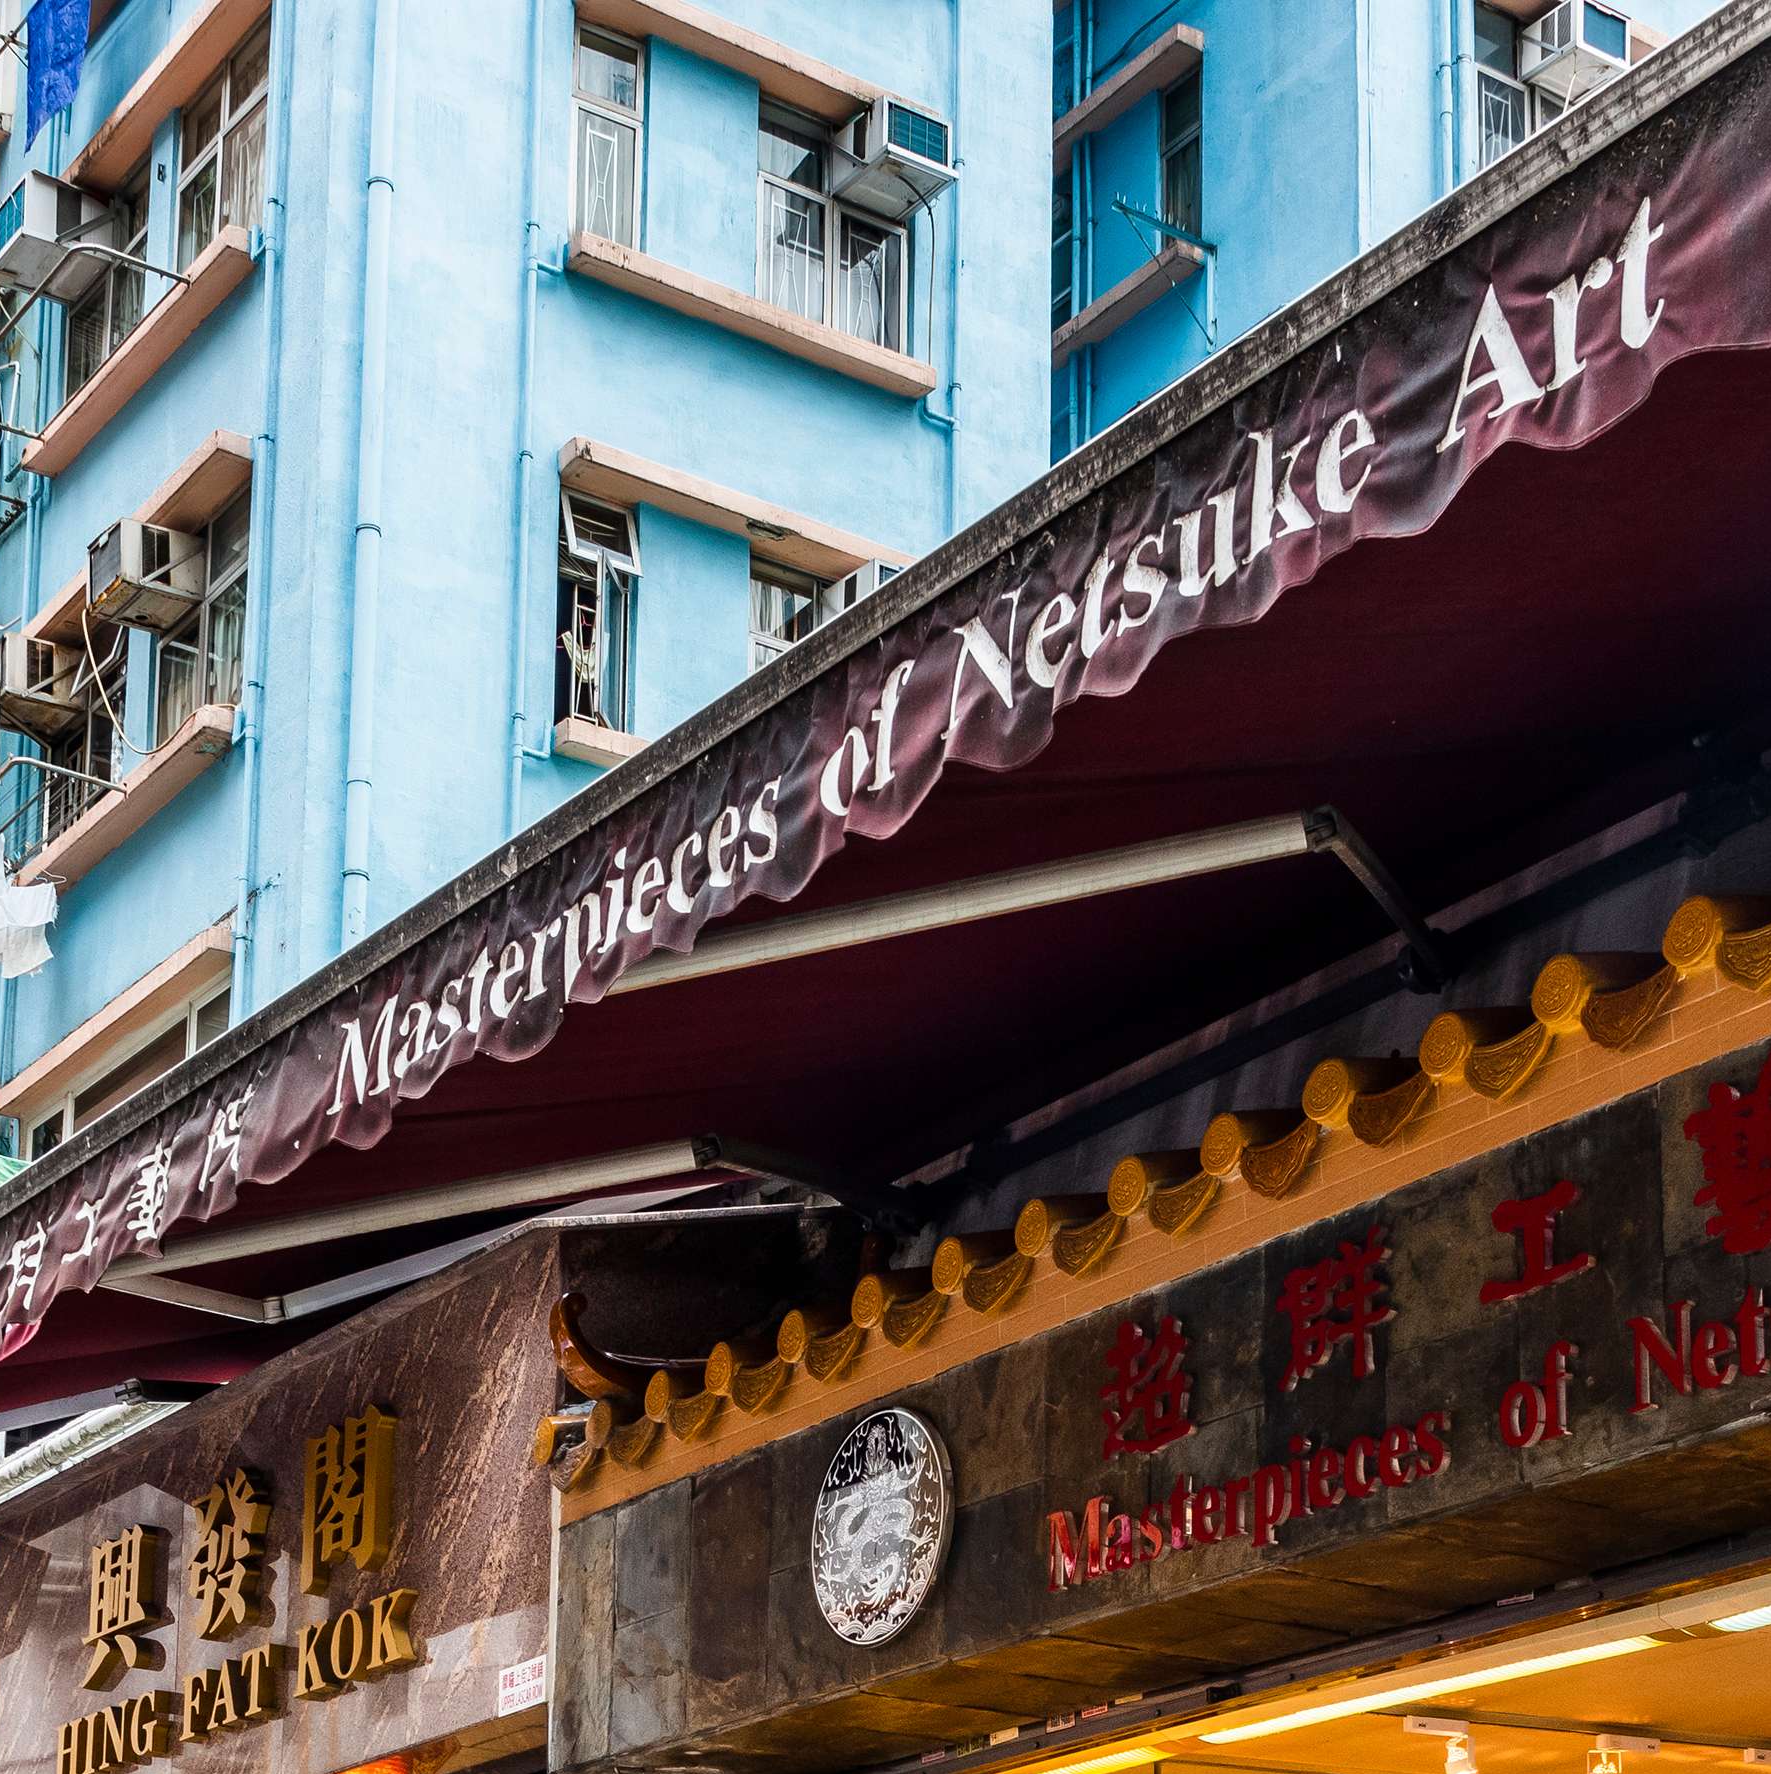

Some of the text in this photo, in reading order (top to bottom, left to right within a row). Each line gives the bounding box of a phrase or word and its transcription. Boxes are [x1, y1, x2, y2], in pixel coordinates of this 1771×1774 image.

[328, 197, 1667, 1117] Masterpieces of Netsuke Art
[81, 1403, 398, 1691] 興發閣
[1047, 1406, 1453, 1592] Masterpieces
[1499, 1340, 1578, 1451] of
[180, 1645, 283, 1743] FAT
[294, 1588, 417, 1700] KOK
